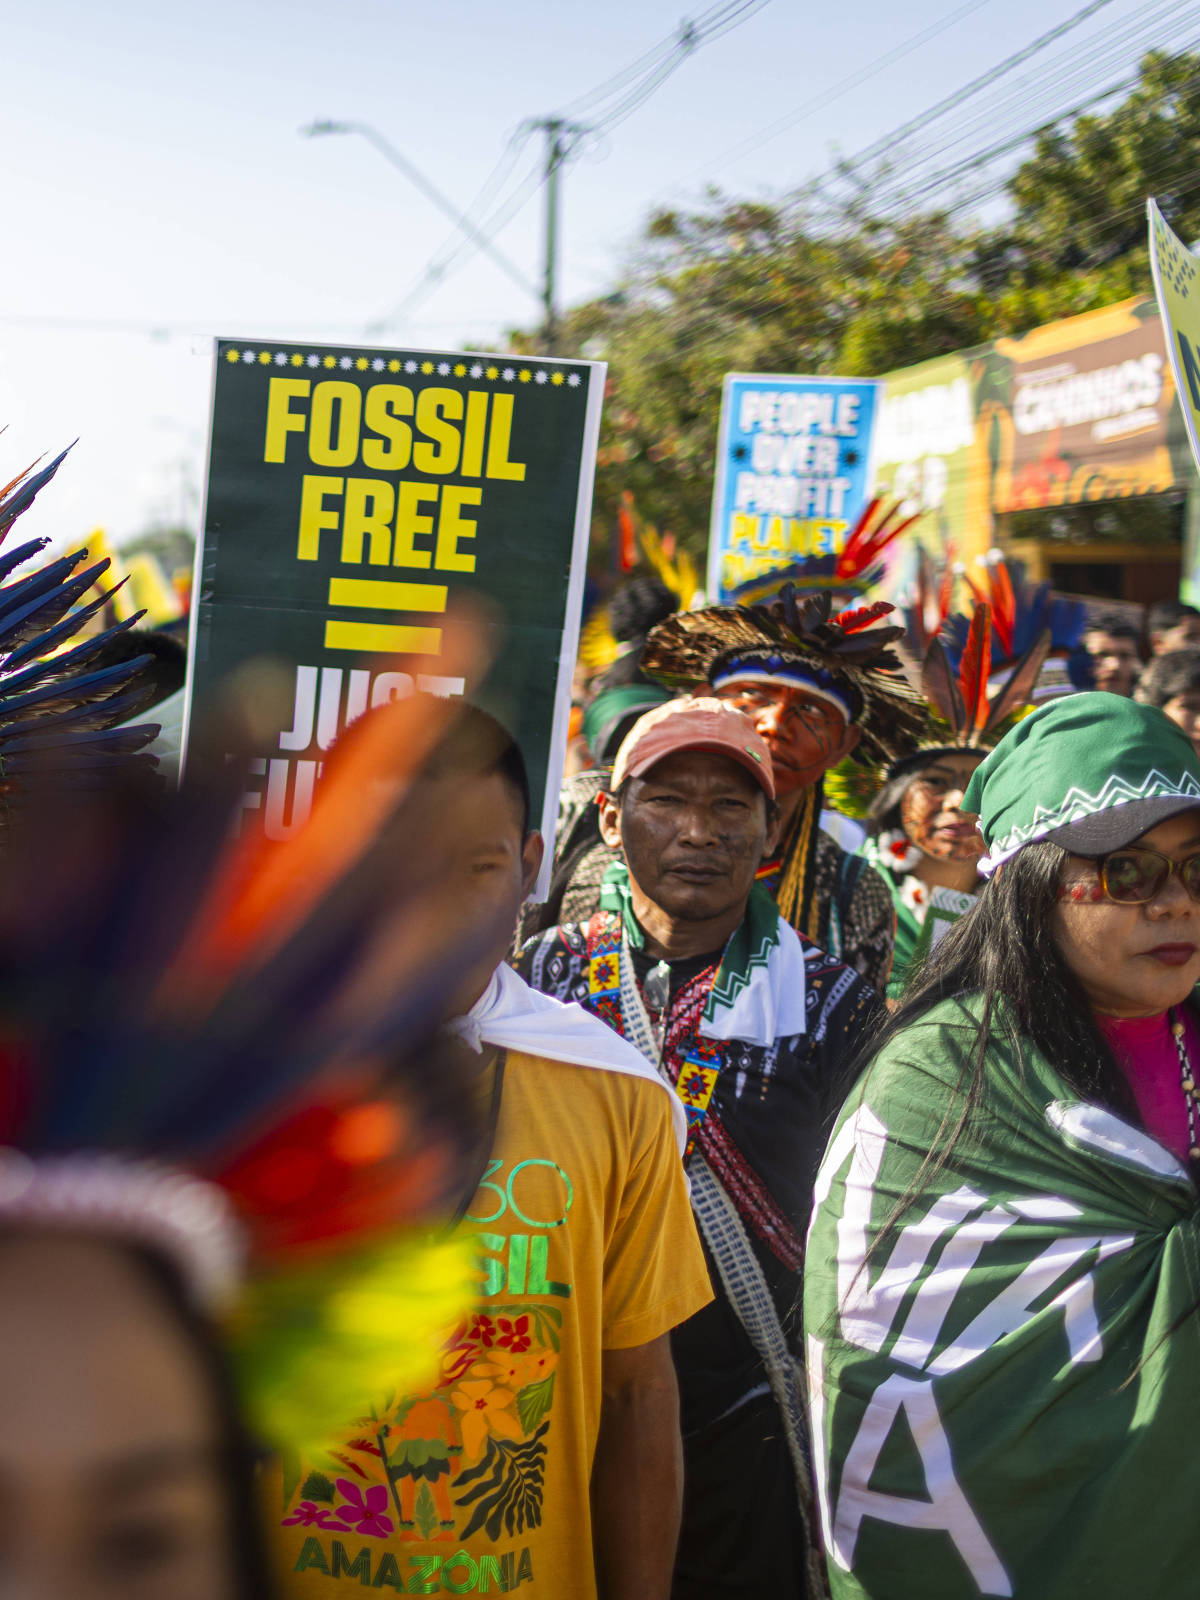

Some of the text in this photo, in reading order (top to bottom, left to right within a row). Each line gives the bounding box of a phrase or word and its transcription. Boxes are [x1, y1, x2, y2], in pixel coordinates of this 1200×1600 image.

[263, 377, 527, 481] FOSSIL
[740, 391, 860, 437] PEOPLE
[752, 433, 840, 478] OVER
[735, 471, 852, 519] PROFIT
[296, 474, 483, 572] FREE
[728, 514, 848, 556] PLANET
[293, 1536, 535, 1595] AMAZÔNIA
